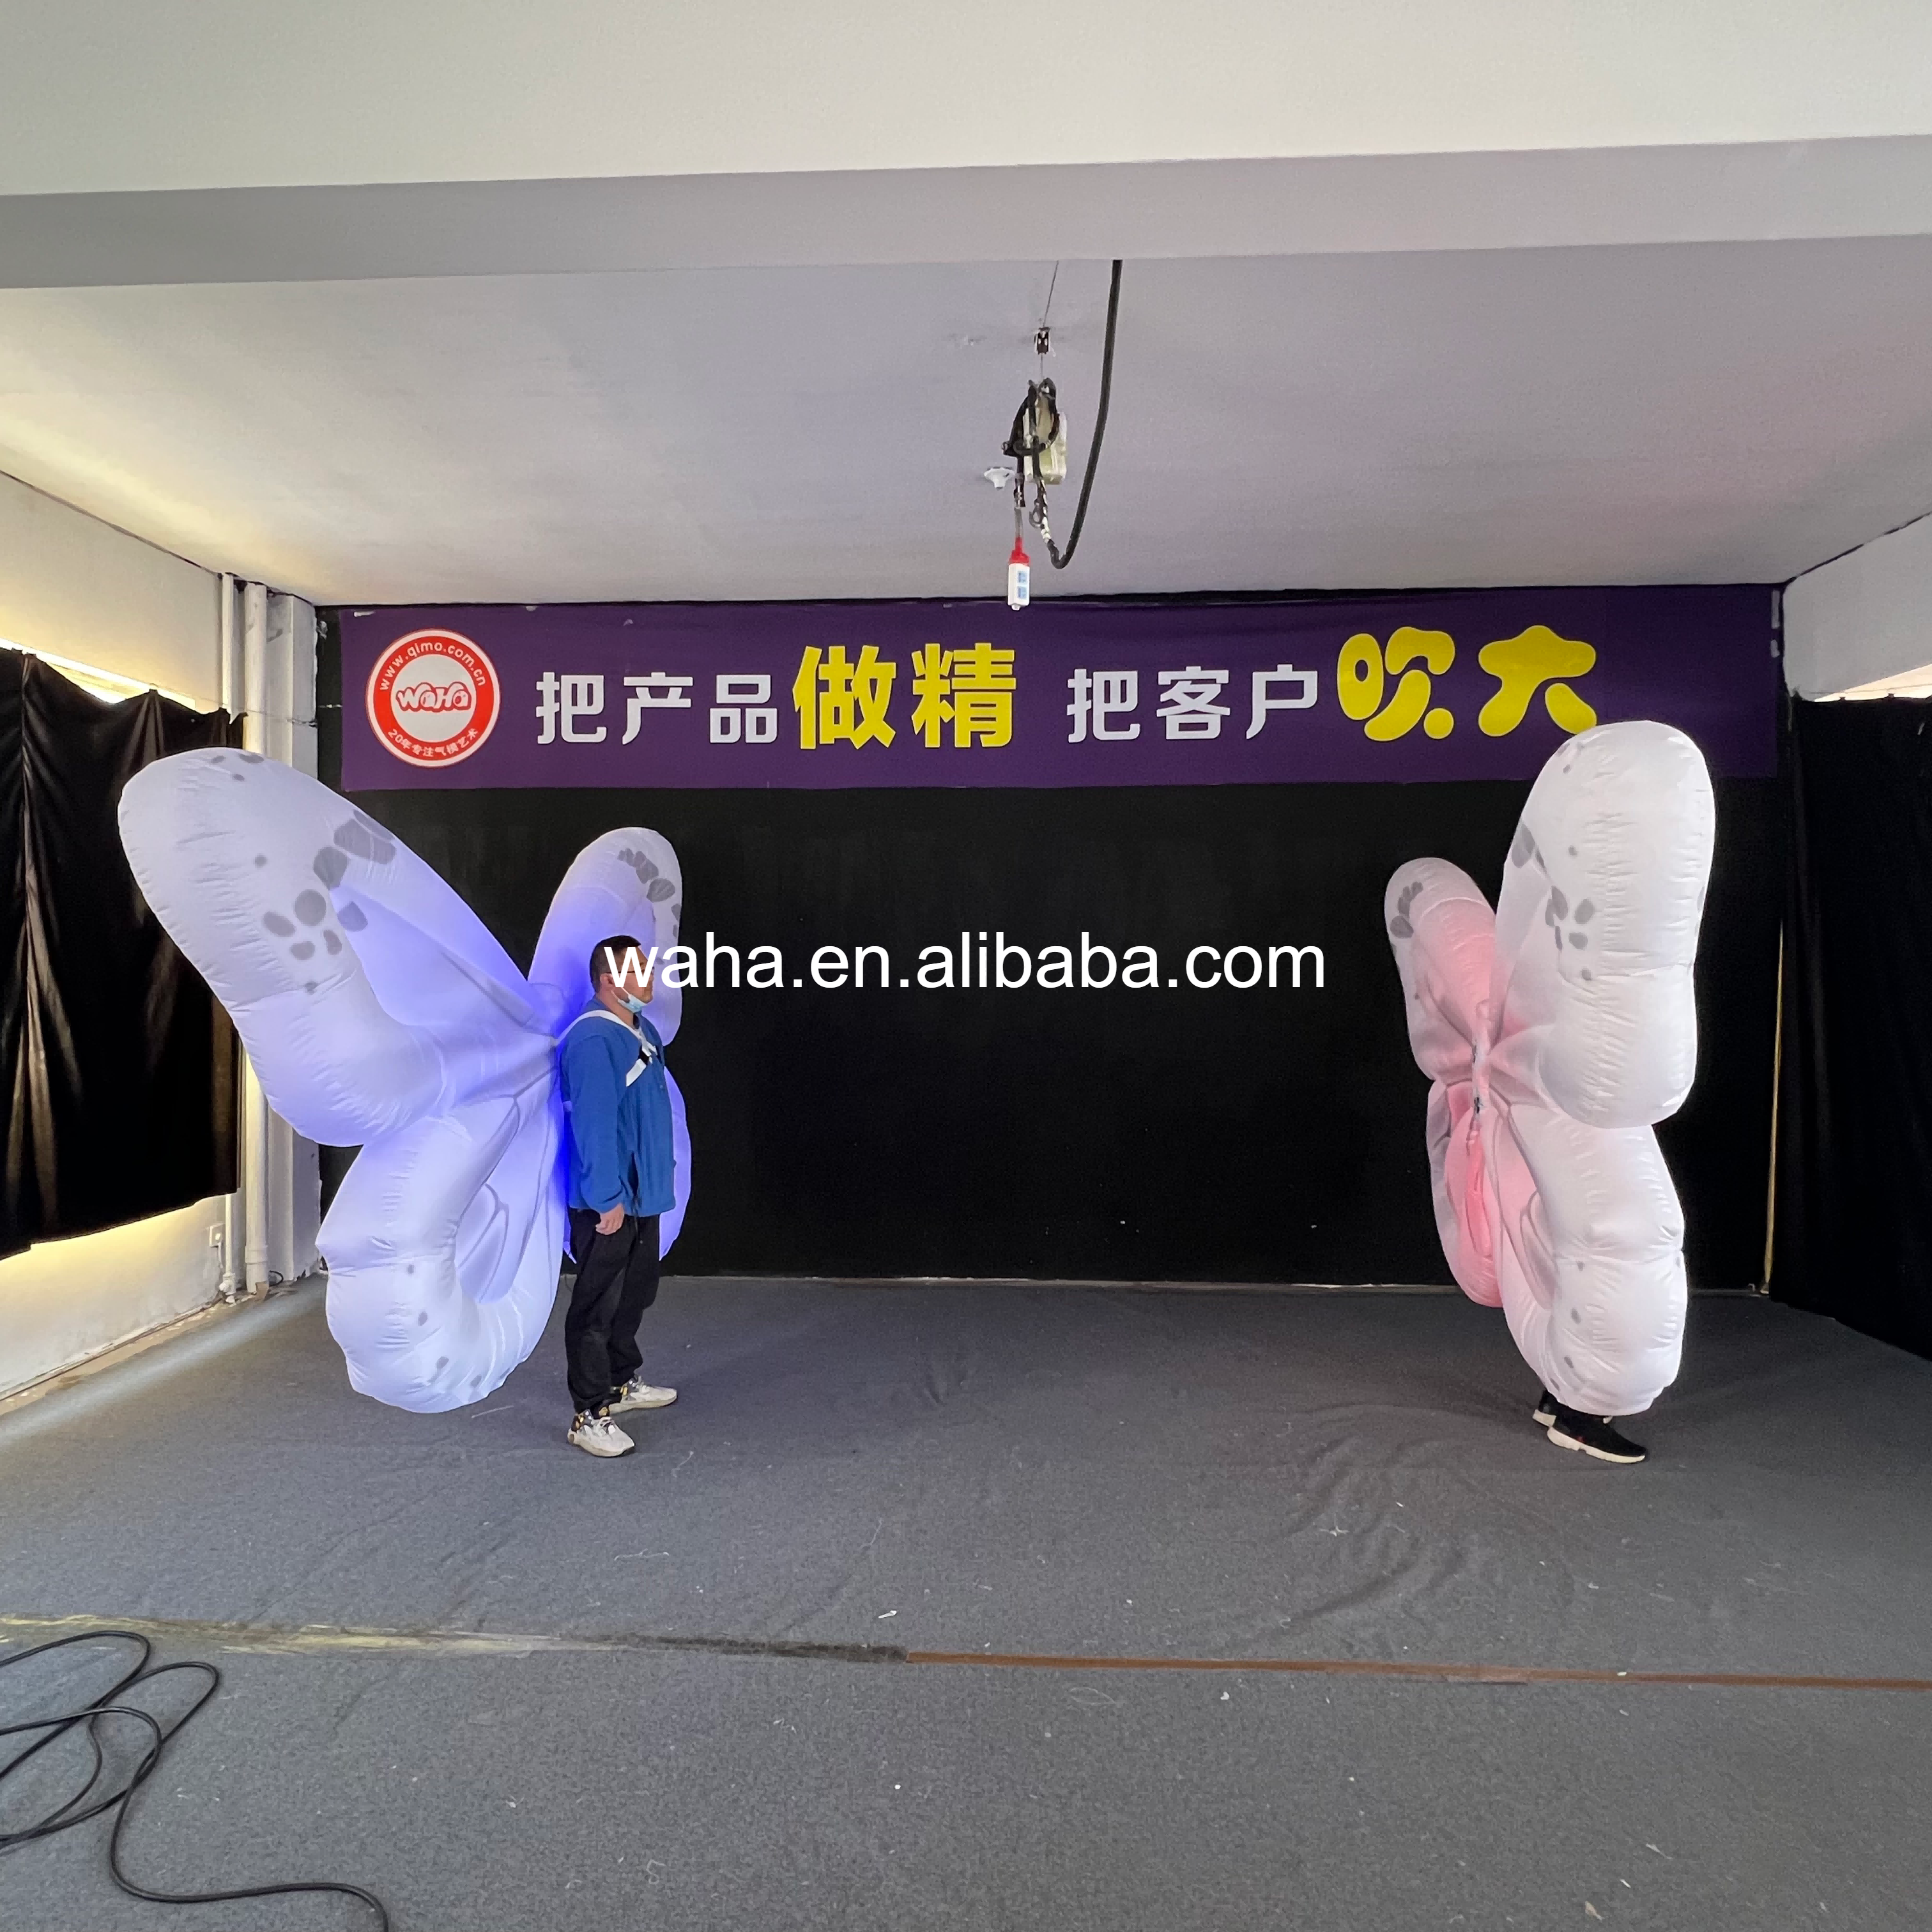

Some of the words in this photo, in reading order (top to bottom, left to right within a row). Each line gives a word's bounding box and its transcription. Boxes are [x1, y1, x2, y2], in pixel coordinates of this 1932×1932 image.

[535, 643, 1016, 749] 把产品做精
[1066, 625, 1597, 741] 把客户吹大
